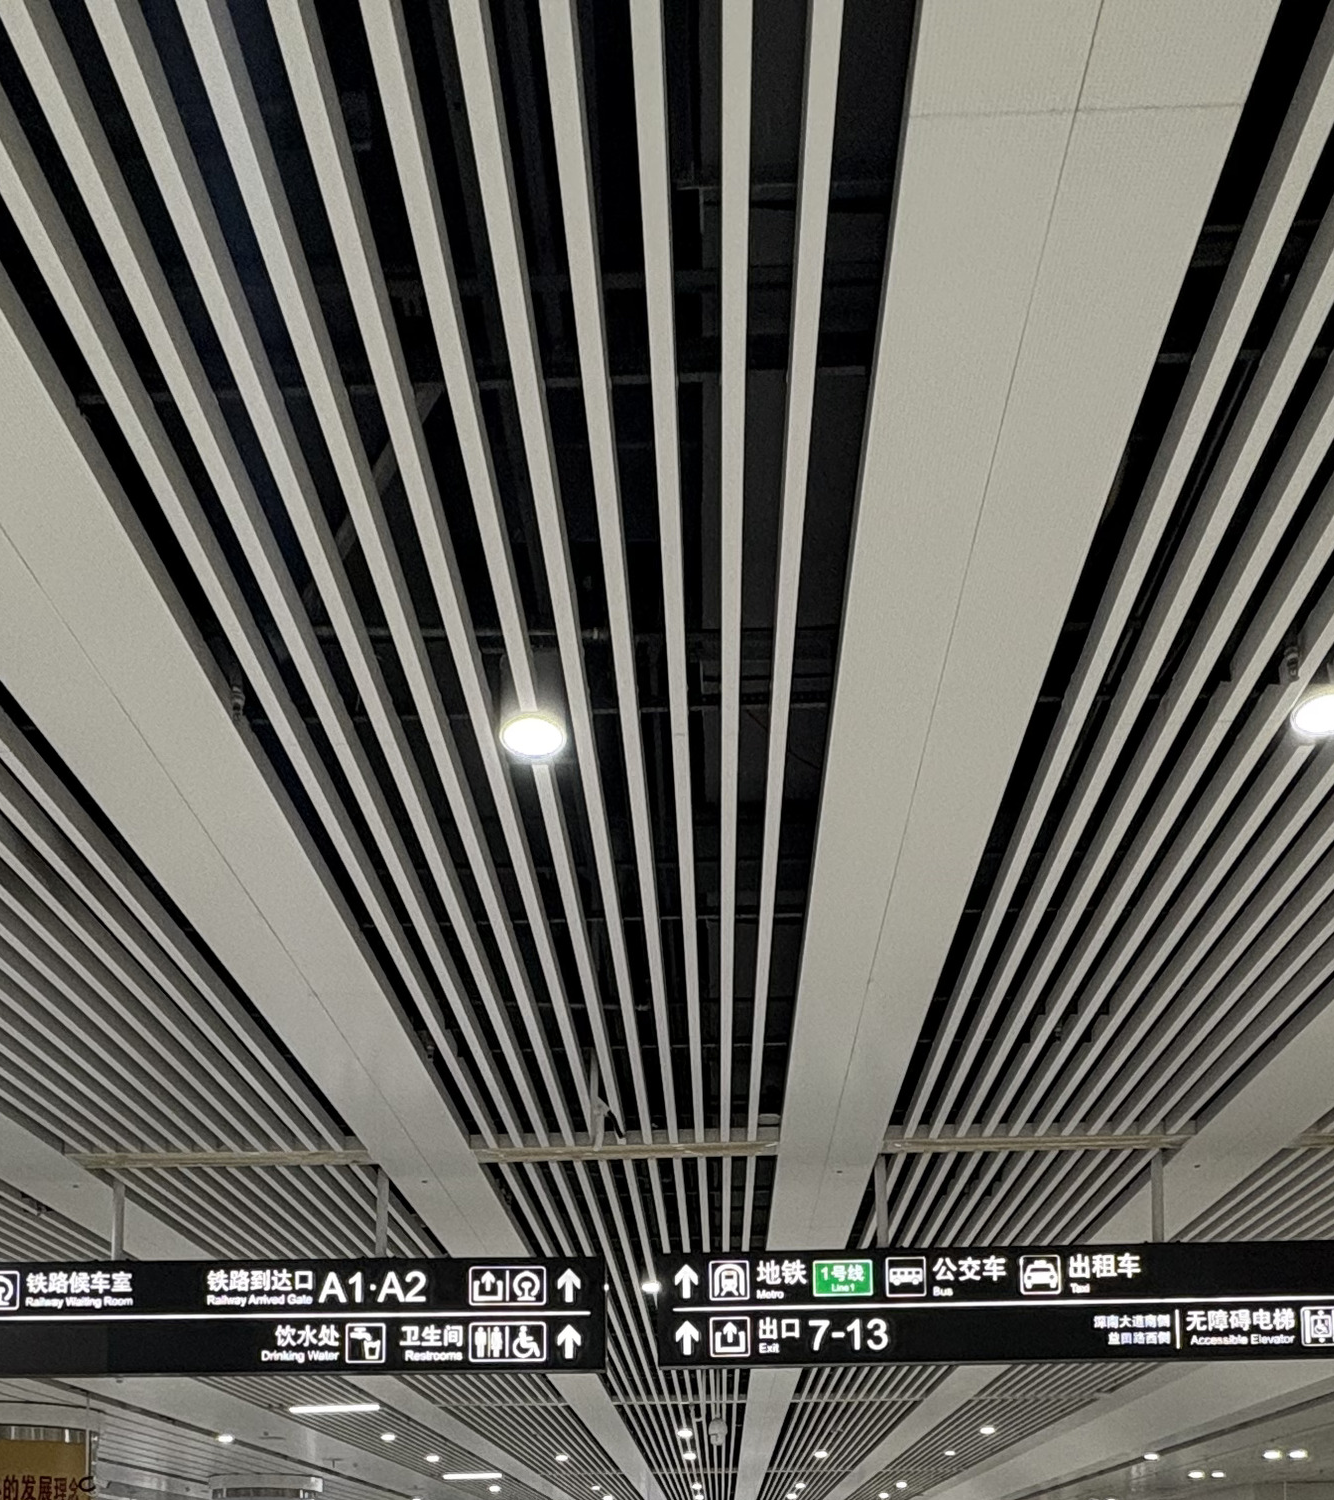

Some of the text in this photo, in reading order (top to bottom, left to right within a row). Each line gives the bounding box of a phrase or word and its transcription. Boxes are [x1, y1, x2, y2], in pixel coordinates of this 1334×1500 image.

[757, 1259, 808, 1285] 地铁
[820, 1264, 865, 1283] 1号线
[933, 1255, 1007, 1281] 公交车
[1068, 1253, 1141, 1278] 出租车
[26, 1271, 133, 1294] 铁路候车室
[207, 1268, 314, 1292] 铁路到达口
[831, 1283, 847, 1292] Line
[1070, 1283, 1091, 1294] Taxi
[756, 1289, 785, 1300] Metro
[933, 1286, 954, 1296] Bus
[25, 1296, 134, 1309] Railway Waiting Room
[207, 1295, 247, 1308] Railway
[288, 1293, 314, 1305] Gate
[1186, 1308, 1296, 1332] 无障碍电梯
[275, 1324, 340, 1347] 饮水处
[399, 1324, 463, 1347] 卫生间
[759, 1317, 889, 1351] 出口 7-13
[1191, 1333, 1295, 1346] Accessible Elevator
[261, 1350, 340, 1364] Drinking Water
[405, 1350, 463, 1362] Restrooms
[759, 1343, 780, 1354] Exit
